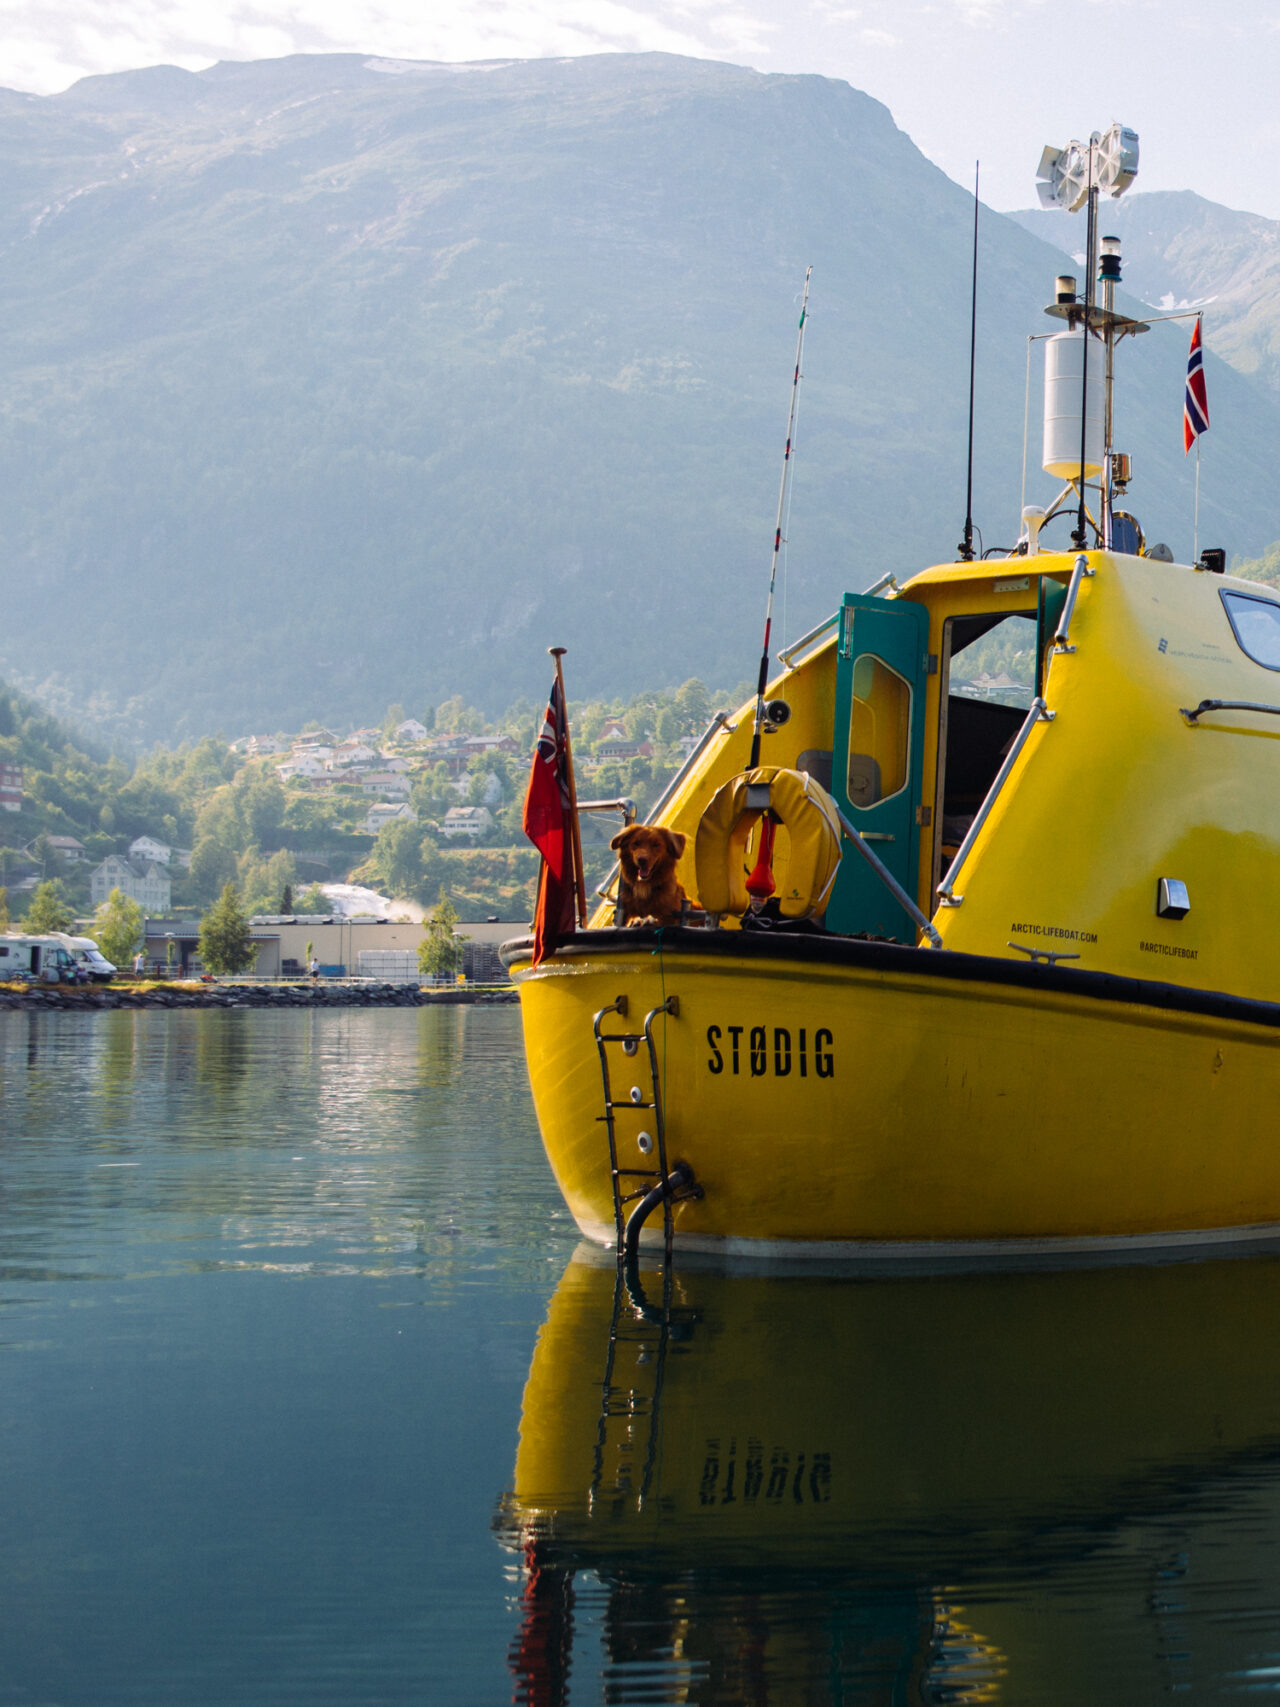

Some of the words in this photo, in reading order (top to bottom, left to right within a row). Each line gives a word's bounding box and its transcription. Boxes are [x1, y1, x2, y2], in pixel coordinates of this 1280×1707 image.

[1011, 923, 1098, 943] ARCTIC-LIFEBOAT.COM
[1139, 941, 1198, 960] @ARCTICLIFEBOAT
[707, 1024, 835, 1078] STØDIG
